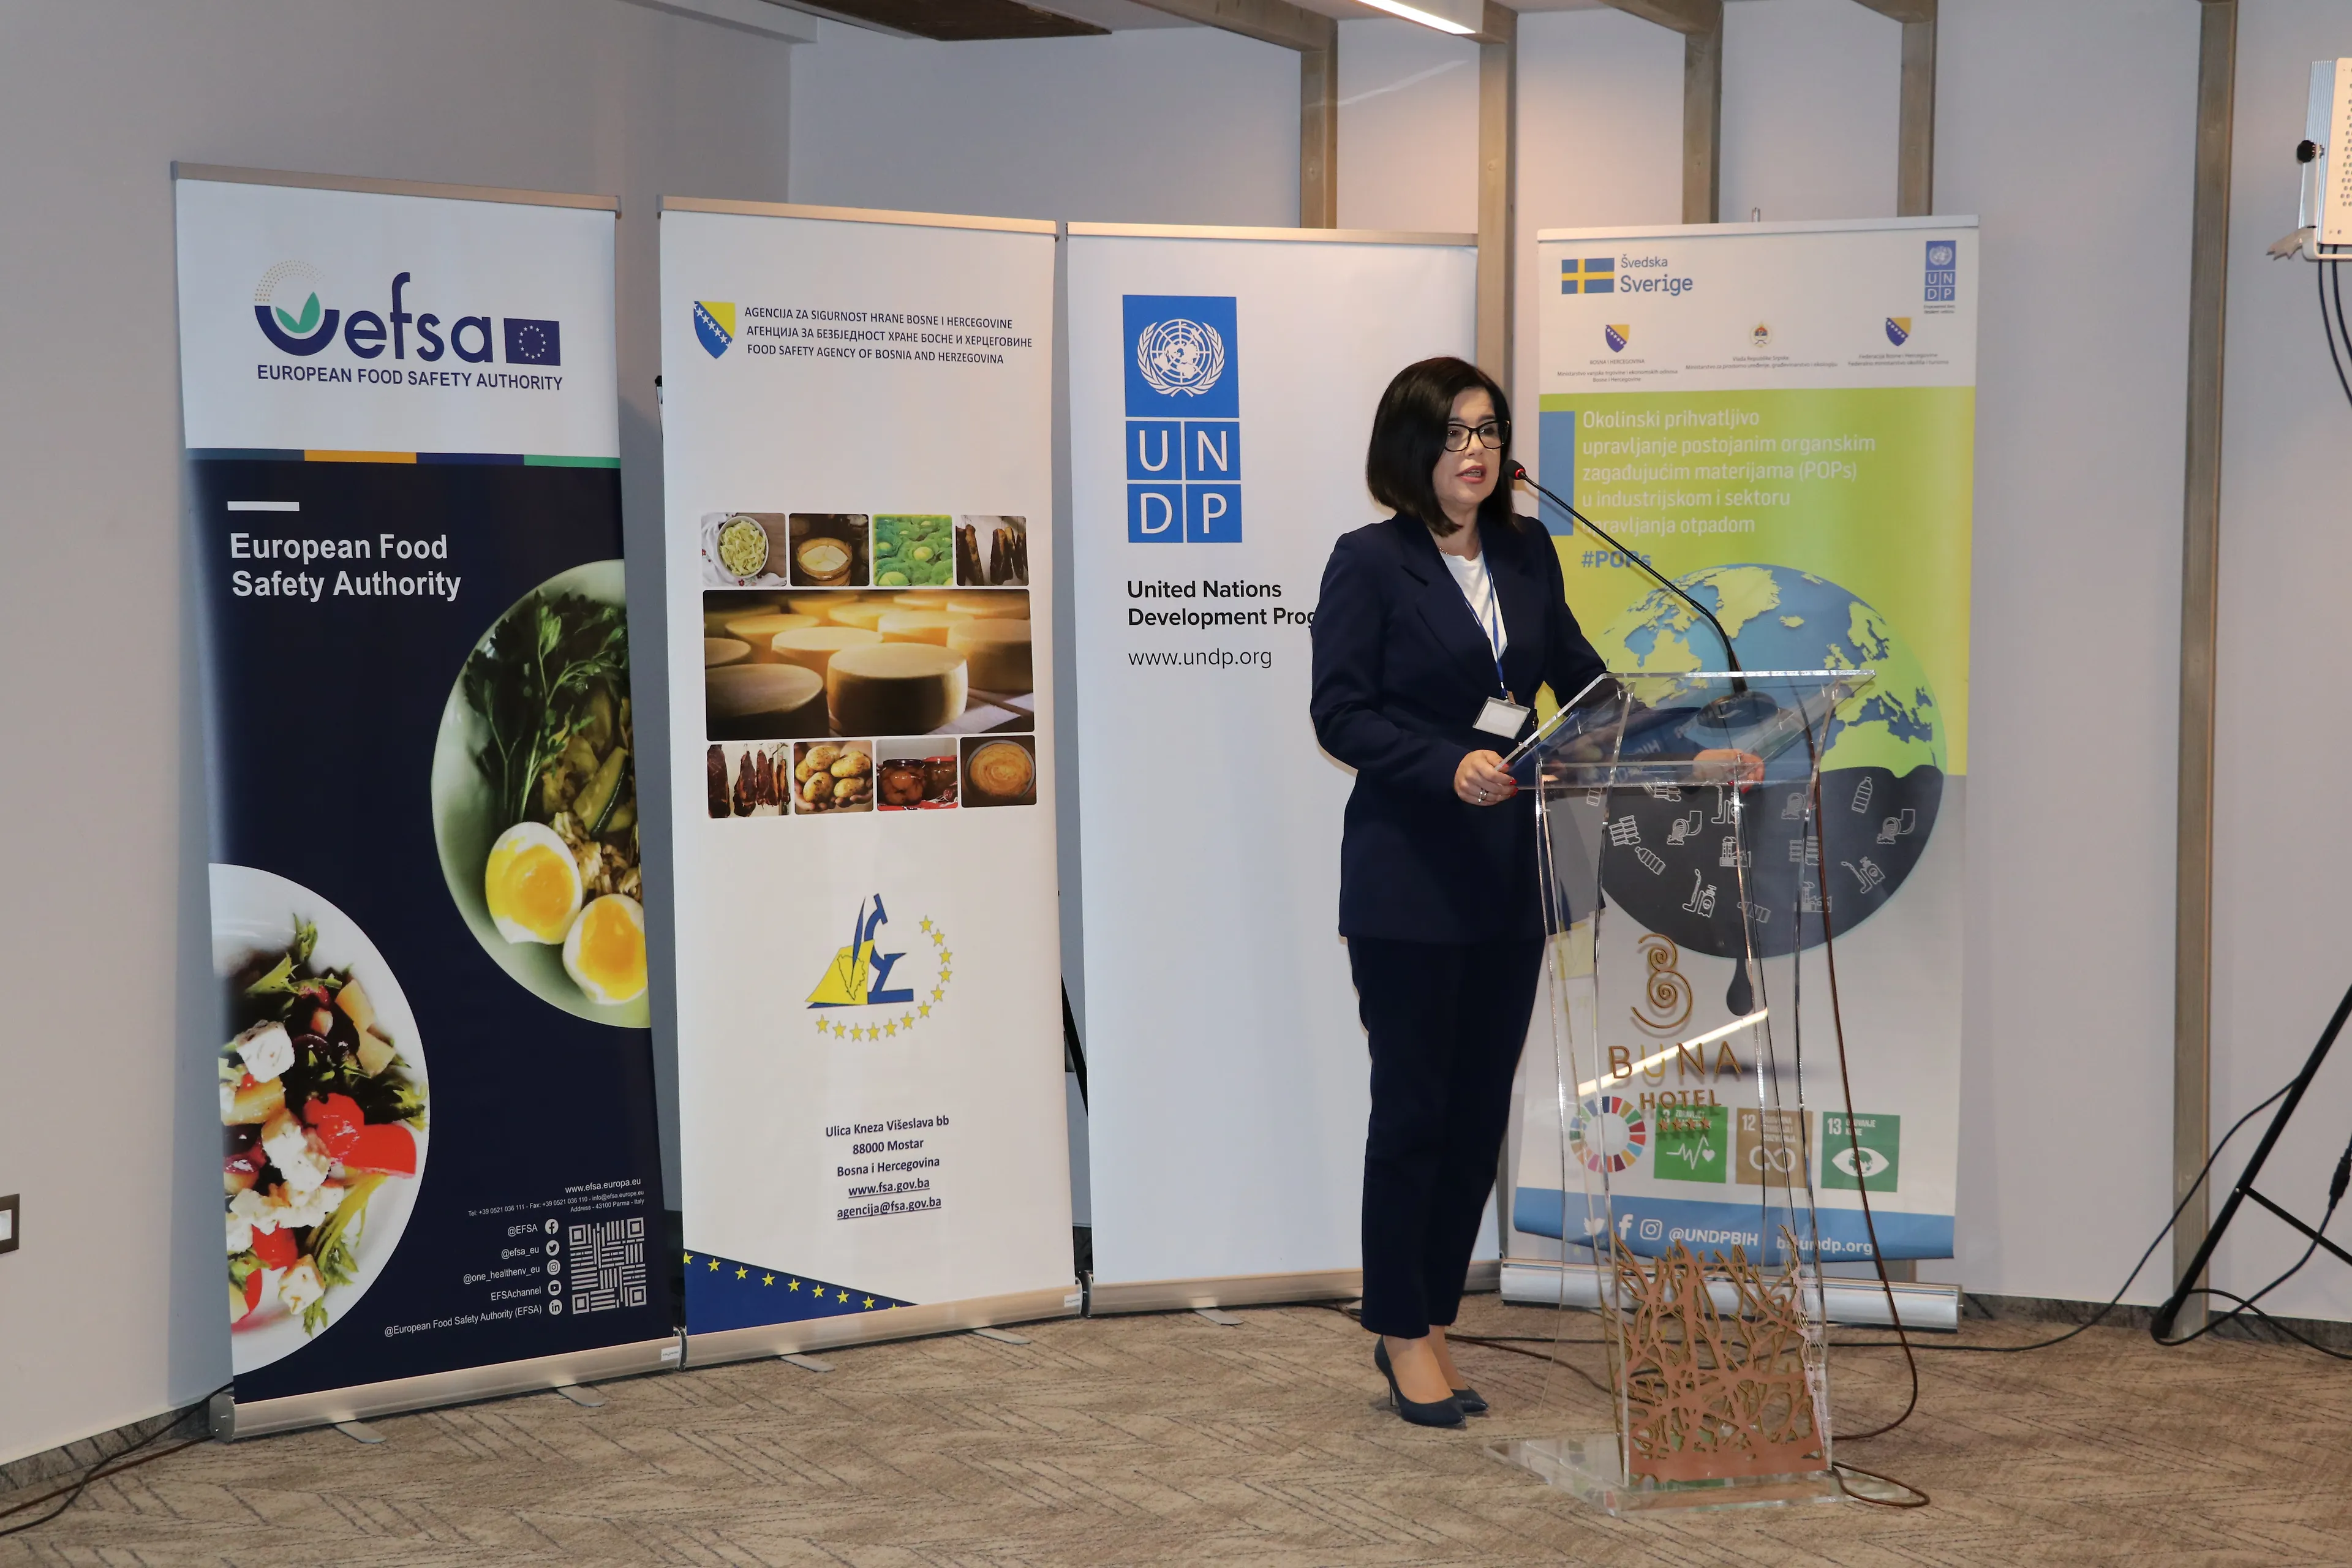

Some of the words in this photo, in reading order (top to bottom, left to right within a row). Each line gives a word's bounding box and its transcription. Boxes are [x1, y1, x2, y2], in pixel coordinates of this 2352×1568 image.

[1621, 254, 1668, 268] Švedska
[1620, 274, 1693, 296] Sverige
[344, 272, 493, 364] efsa
[745, 307, 793, 318] AGENCIJA
[796, 310, 809, 319] ZA
[812, 311, 867, 322] SIGURNOST
[871, 313, 903, 323] HRANE
[907, 315, 938, 325] BOSNE
[948, 317, 1012, 328] HERCEGOVINE
[747, 326, 799, 338] АГЕНЦИЈА
[802, 328, 813, 337] ЗА
[817, 329, 885, 342] БЕЗБЈЕДНОСТ
[889, 332, 918, 342] ХРАНЕ
[921, 334, 952, 344] БОСНЕ
[965, 336, 1031, 347] ХЕРЦЕГОВИНЕ
[748, 344, 775, 354] FOOD
[779, 345, 813, 356] SAFETY
[817, 347, 855, 358] AGENCY
[859, 349, 872, 358] OF
[876, 350, 911, 360] BOSNIA
[914, 352, 935, 360] AND
[939, 352, 1003, 363] HERZEGOVINA
[258, 365, 352, 382] EUROPEAN
[358, 369, 402, 384] FOOD
[409, 371, 472, 386] SAFETY
[477, 374, 562, 390] AUTHORITY
[1583, 410, 1659, 428] Okolinski
[1665, 409, 1759, 430] prihvatljivo
[1583, 437, 1676, 458] upravljanje
[1682, 435, 1776, 456] postojanim
[1782, 434, 1875, 455] organskim
[1583, 463, 1689, 484] zagađujućim
[1695, 462, 1793, 482] materijama
[1800, 461, 1856, 482] (POPs)
[1583, 494, 1593, 507] u
[1597, 489, 1712, 510] industrijskom
[1725, 489, 1790, 507] sektoru
[1681, 516, 1755, 535] otpadom
[231, 533, 370, 565] European
[380, 534, 447, 559] Food
[1581, 550, 1652, 568] #POPs
[233, 571, 325, 602] Safety
[333, 571, 461, 601] Authority
[1128, 581, 1196, 598] United
[1204, 580, 1281, 597] Nations
[1129, 608, 1267, 630] Development
[1128, 648, 1271, 669] www.undp.org
[1608, 1041, 1743, 1079] BUNA
[1640, 1089, 1722, 1109] HOTEL
[826, 1126, 850, 1137] Ulica
[854, 1124, 883, 1134] Kneza
[887, 1118, 933, 1131] Višeslava
[937, 1115, 949, 1126] bb
[1742, 1114, 1755, 1131] 12
[1827, 1118, 1841, 1134] 13
[853, 1142, 884, 1155] 88000
[888, 1140, 924, 1151] Mostar
[837, 1166, 868, 1177] Bosna
[878, 1158, 939, 1172] Hercegovina
[565, 1179, 641, 1193] www.efsa.europa.eu
[849, 1178, 930, 1196] www.fsa.gov.ba
[837, 1197, 941, 1219] agencija@fsa.gov.ba
[508, 1224, 538, 1237] @EFSA
[1669, 1227, 1758, 1246] @UNDPBIH
[501, 1246, 540, 1260] @efsa_eu
[464, 1267, 540, 1284] @one_healthenv_eu
[491, 1286, 541, 1300] EFSAchannel
[385, 1323, 431, 1337] @European
[434, 1317, 452, 1328] Food
[455, 1315, 478, 1325] Safety
[480, 1310, 513, 1321] Authority
[515, 1305, 541, 1317] (EFSA)
